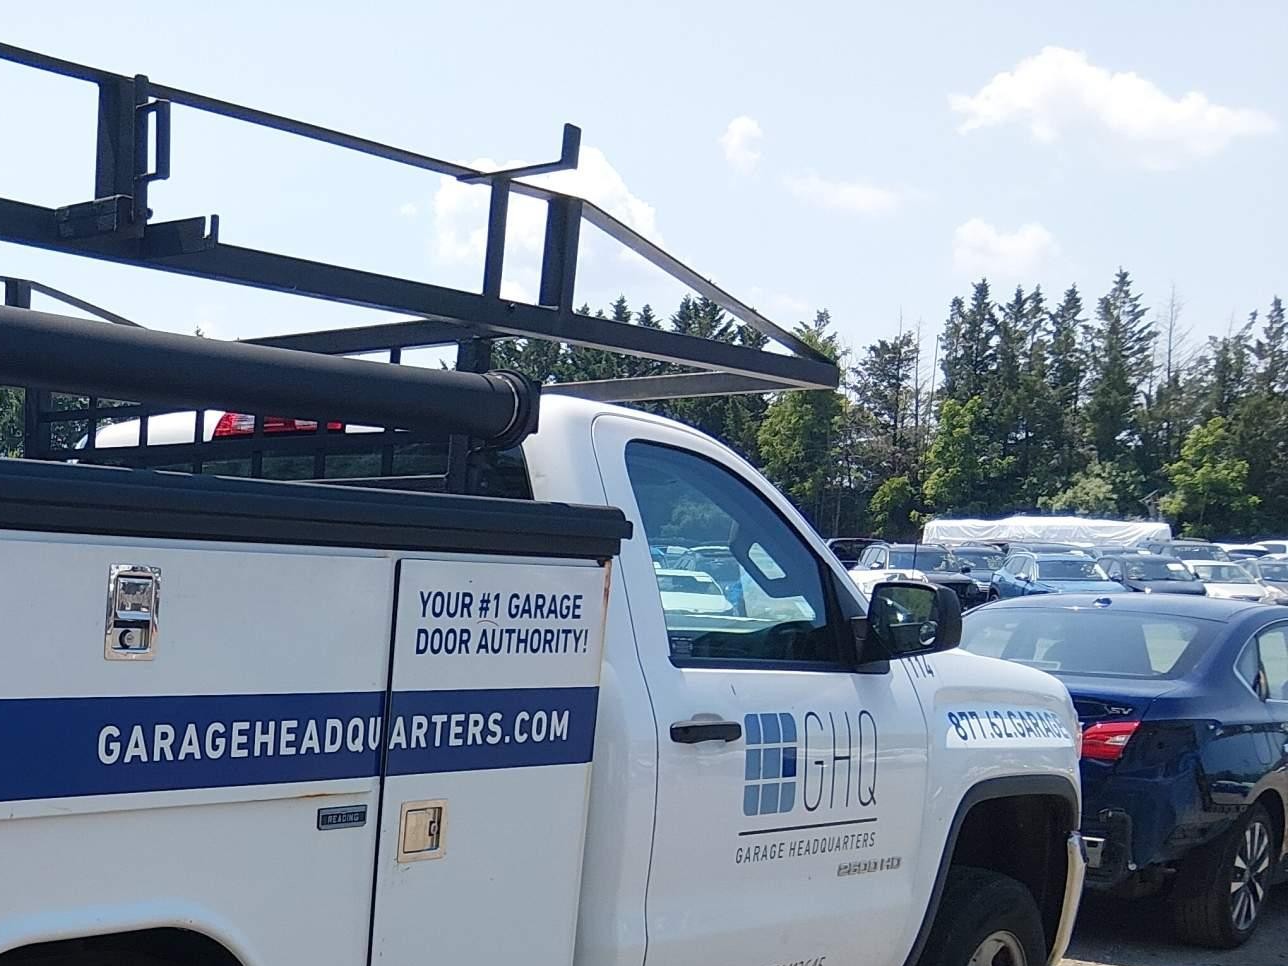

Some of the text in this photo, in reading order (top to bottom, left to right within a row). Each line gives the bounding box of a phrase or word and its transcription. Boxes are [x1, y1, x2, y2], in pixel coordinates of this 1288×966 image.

[419, 591, 584, 620] YOUR #1 GARAGE
[416, 628, 589, 655] DOOR AUTHORITY!
[98, 710, 571, 765] GARAGEHEADQUARTERS.COM
[947, 710, 1070, 742] 877.62.GARAGE
[803, 709, 877, 812] GHQ
[327, 813, 360, 825] READING
[736, 832, 876, 864] GARAGE HEADQUARTERS
